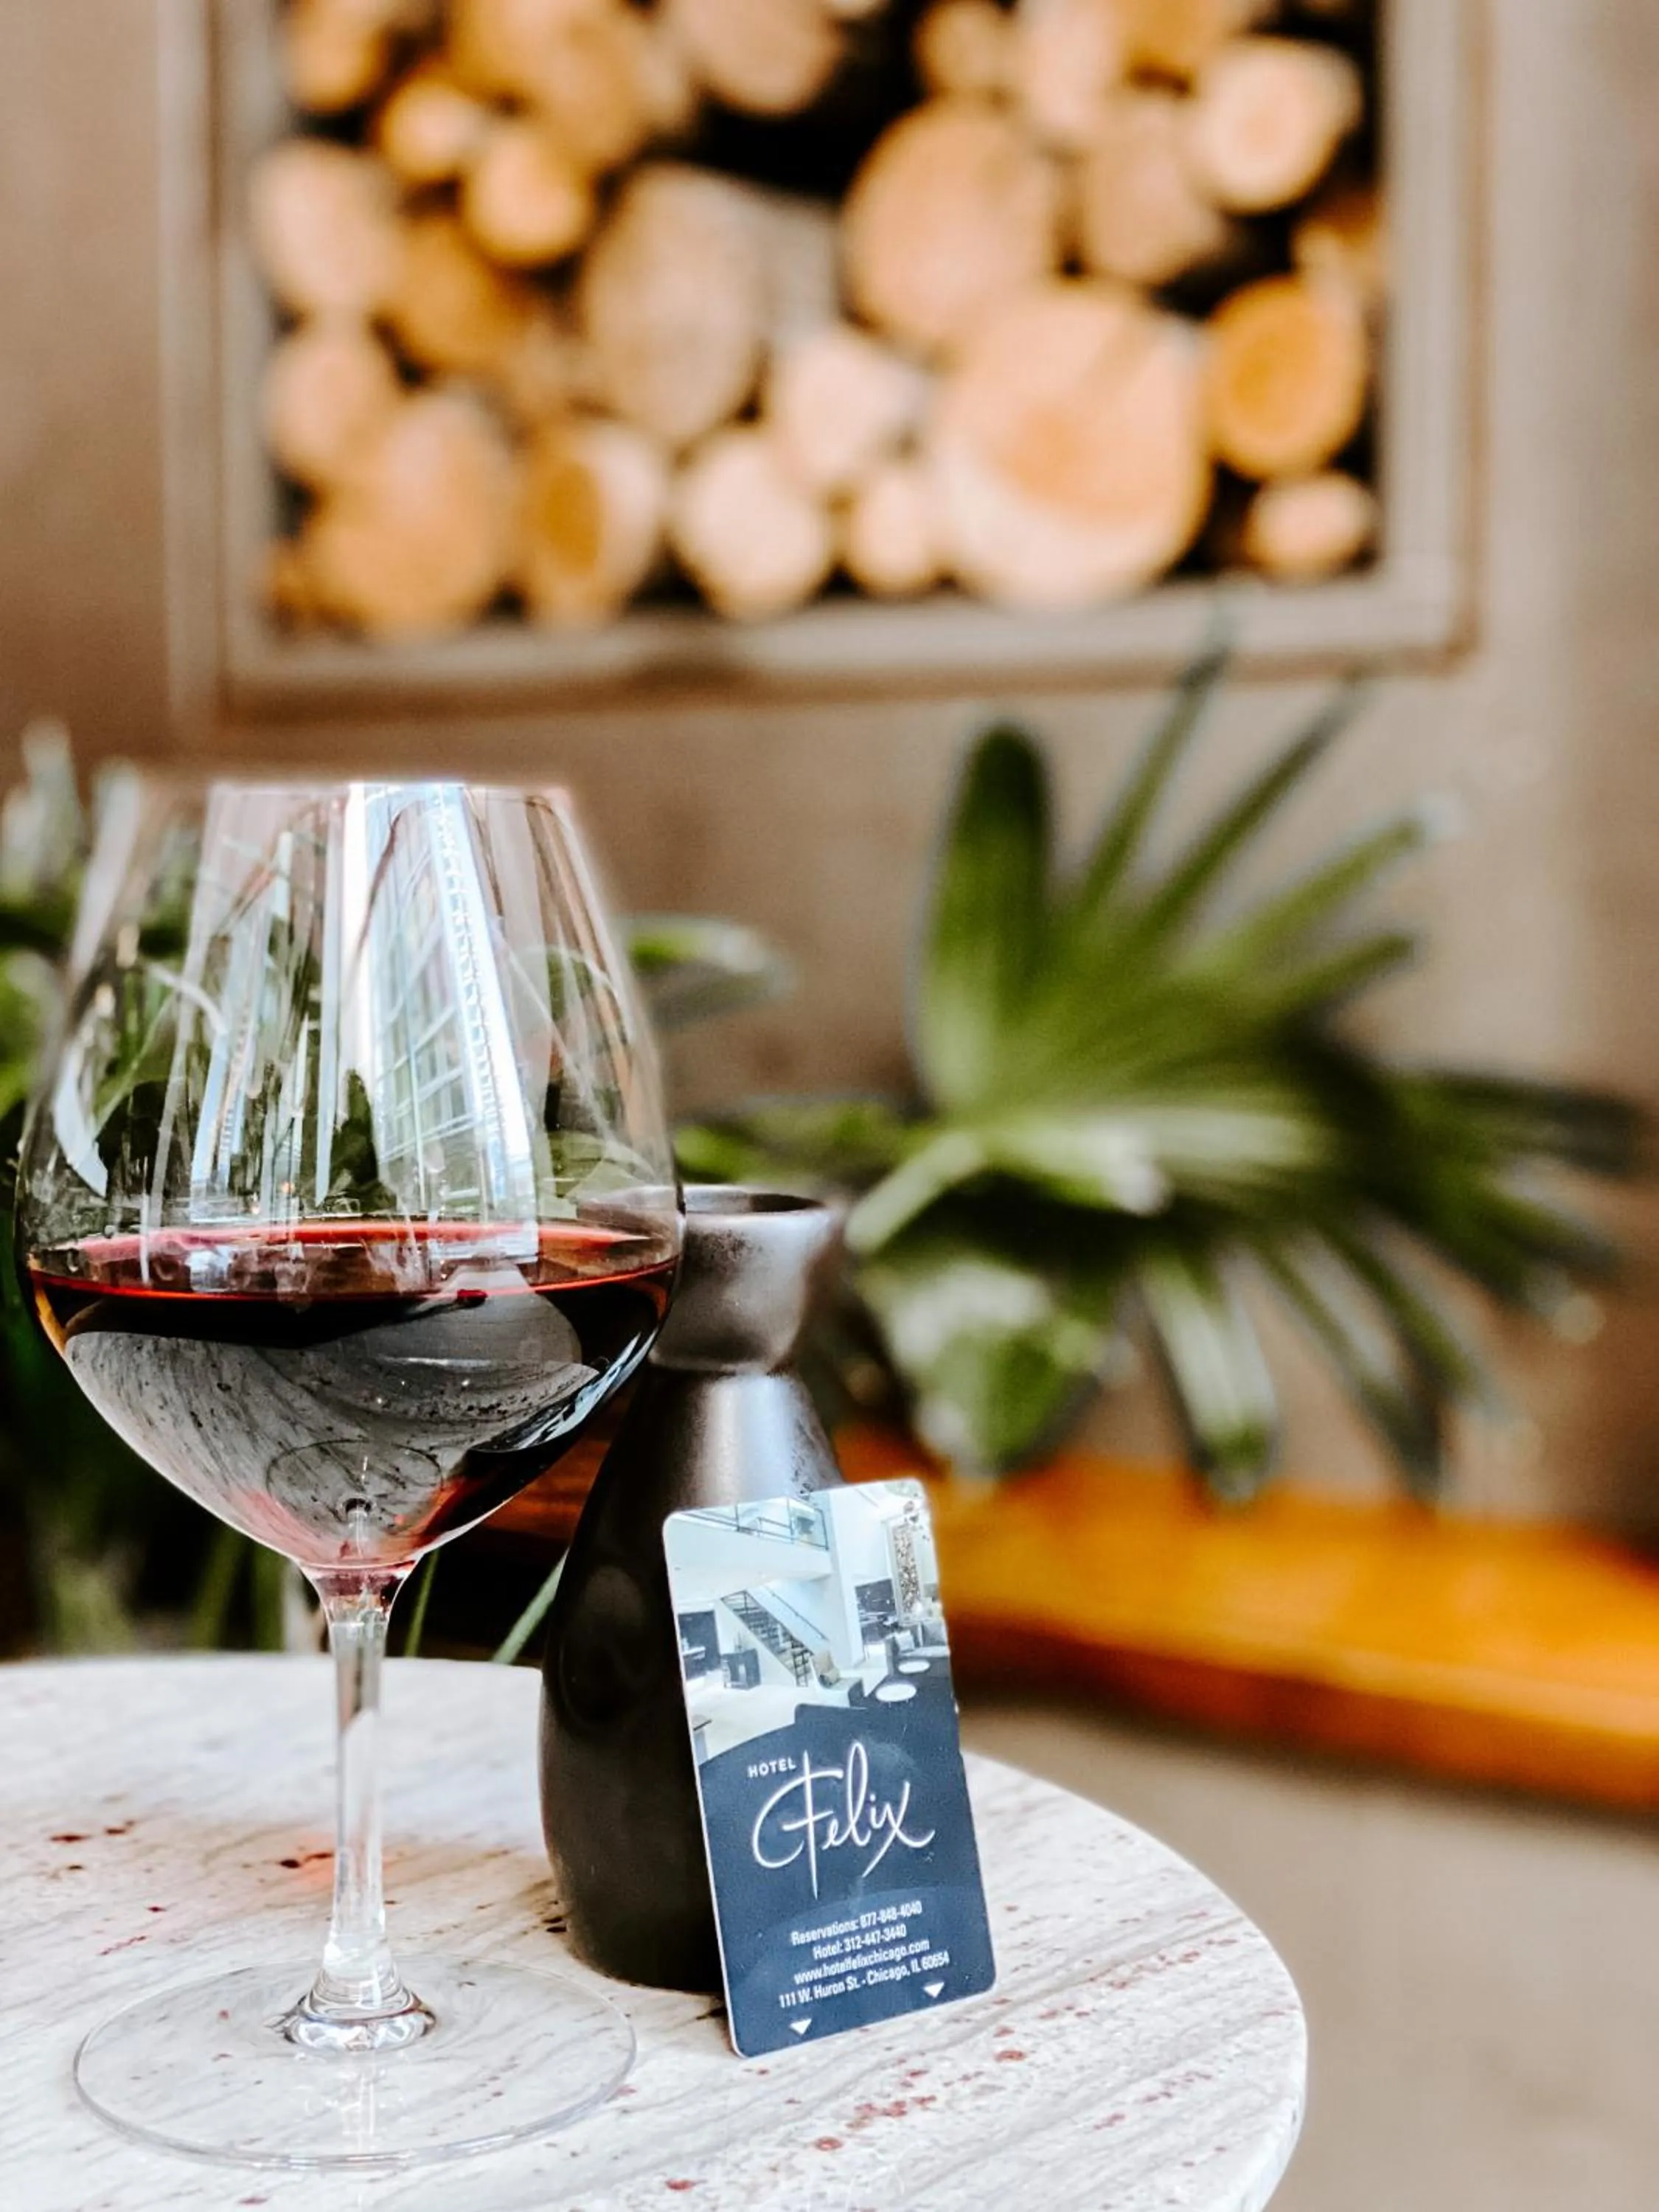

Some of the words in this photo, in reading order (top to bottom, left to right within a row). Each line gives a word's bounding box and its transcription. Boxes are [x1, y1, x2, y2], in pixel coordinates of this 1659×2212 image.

[748, 1757, 797, 1778] HOTEL
[752, 1741, 936, 1900] Felix
[791, 1919, 858, 1945] Reservations:
[813, 1940, 843, 1960] Hotel:
[844, 1924, 907, 1952] 312-447-3440
[779, 1993, 797, 2008] 111
[798, 1988, 813, 2004] W.
[813, 1981, 845, 2000] Huron
[846, 1975, 860, 1991] St.
[866, 1964, 910, 1985] Chicago,
[911, 1958, 921, 1973] IL
[921, 1950, 950, 1970] 60654
[793, 1939, 930, 1984] www.hotelfelixchicago.com
